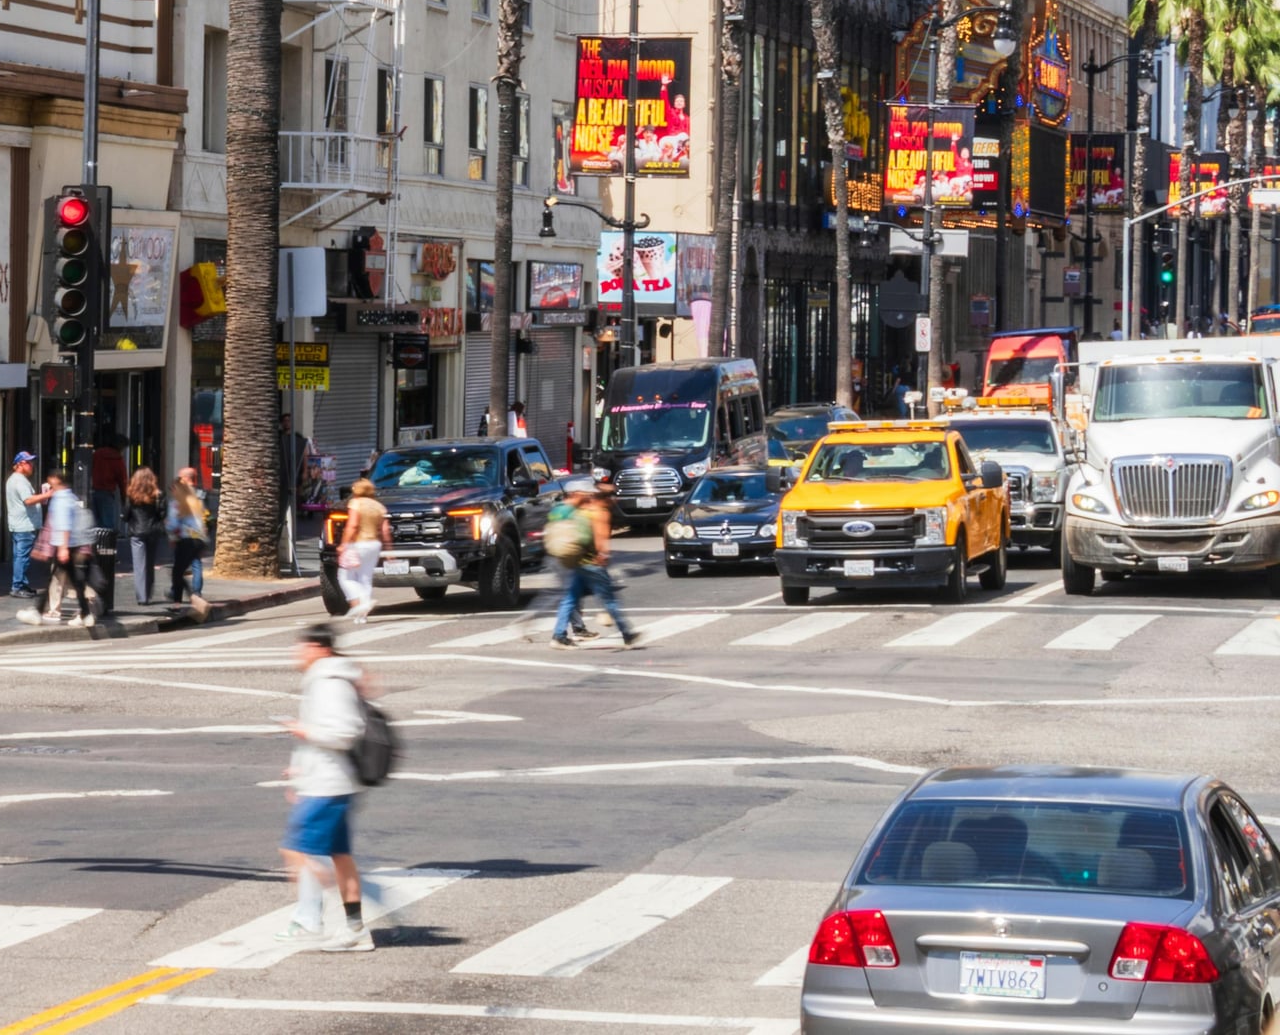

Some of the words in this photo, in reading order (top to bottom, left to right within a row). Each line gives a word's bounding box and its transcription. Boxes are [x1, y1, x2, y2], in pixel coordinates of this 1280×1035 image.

[580, 39, 602, 59] THE
[579, 59, 605, 78] NEIL
[577, 79, 625, 99] MUSICAL
[576, 98, 587, 125] A
[891, 106, 908, 121] THE
[575, 124, 614, 153] NOISE
[888, 149, 896, 170] A
[887, 169, 917, 189] NOISE
[600, 277, 640, 294] BOA
[642, 277, 672, 292] TEA
[277, 373, 325, 381] TOURS
[965, 967, 1039, 990] 7WTV862
